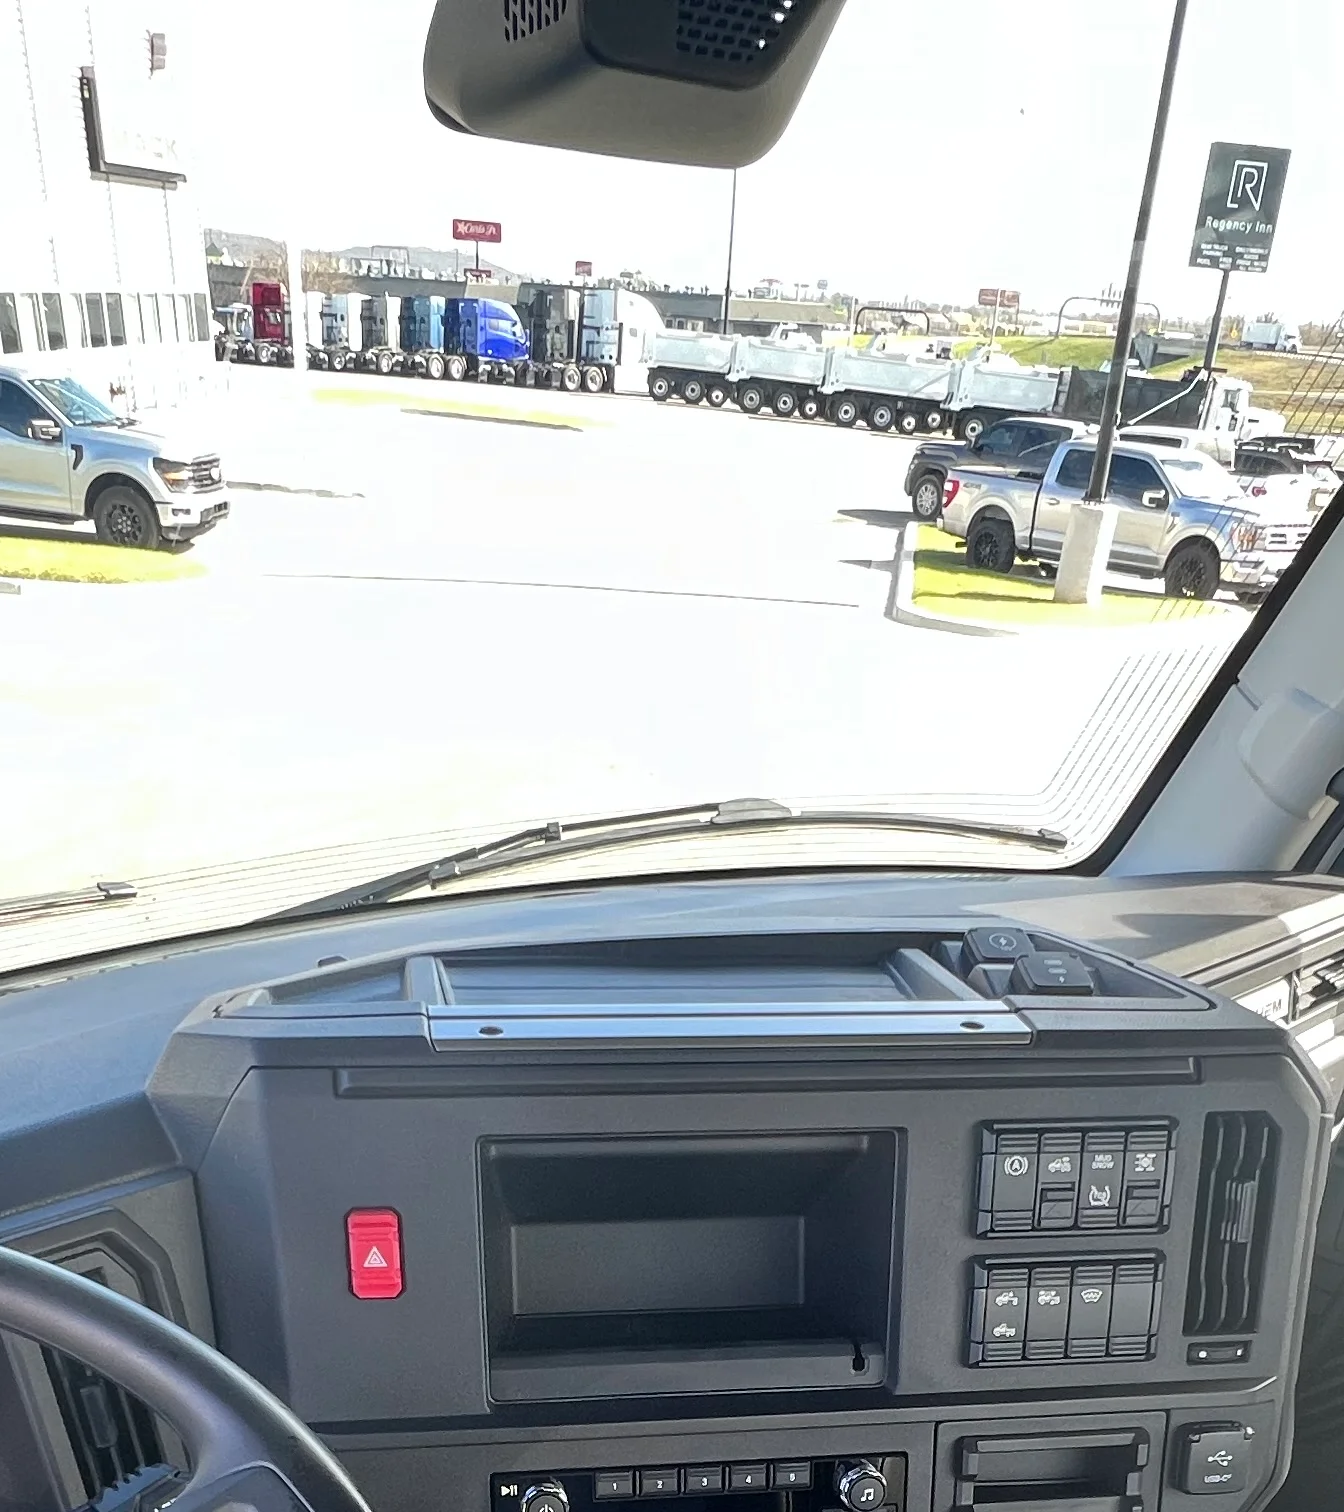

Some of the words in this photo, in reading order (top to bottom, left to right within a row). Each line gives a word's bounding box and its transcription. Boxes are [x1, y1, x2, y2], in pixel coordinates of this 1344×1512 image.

[1205, 216, 1253, 234] Regency
[1255, 221, 1273, 233] Inn
[701, 1477, 708, 1487] 3
[745, 1474, 752, 1484] 4
[612, 1482, 618, 1491] 1
[656, 1480, 663, 1489] 2
